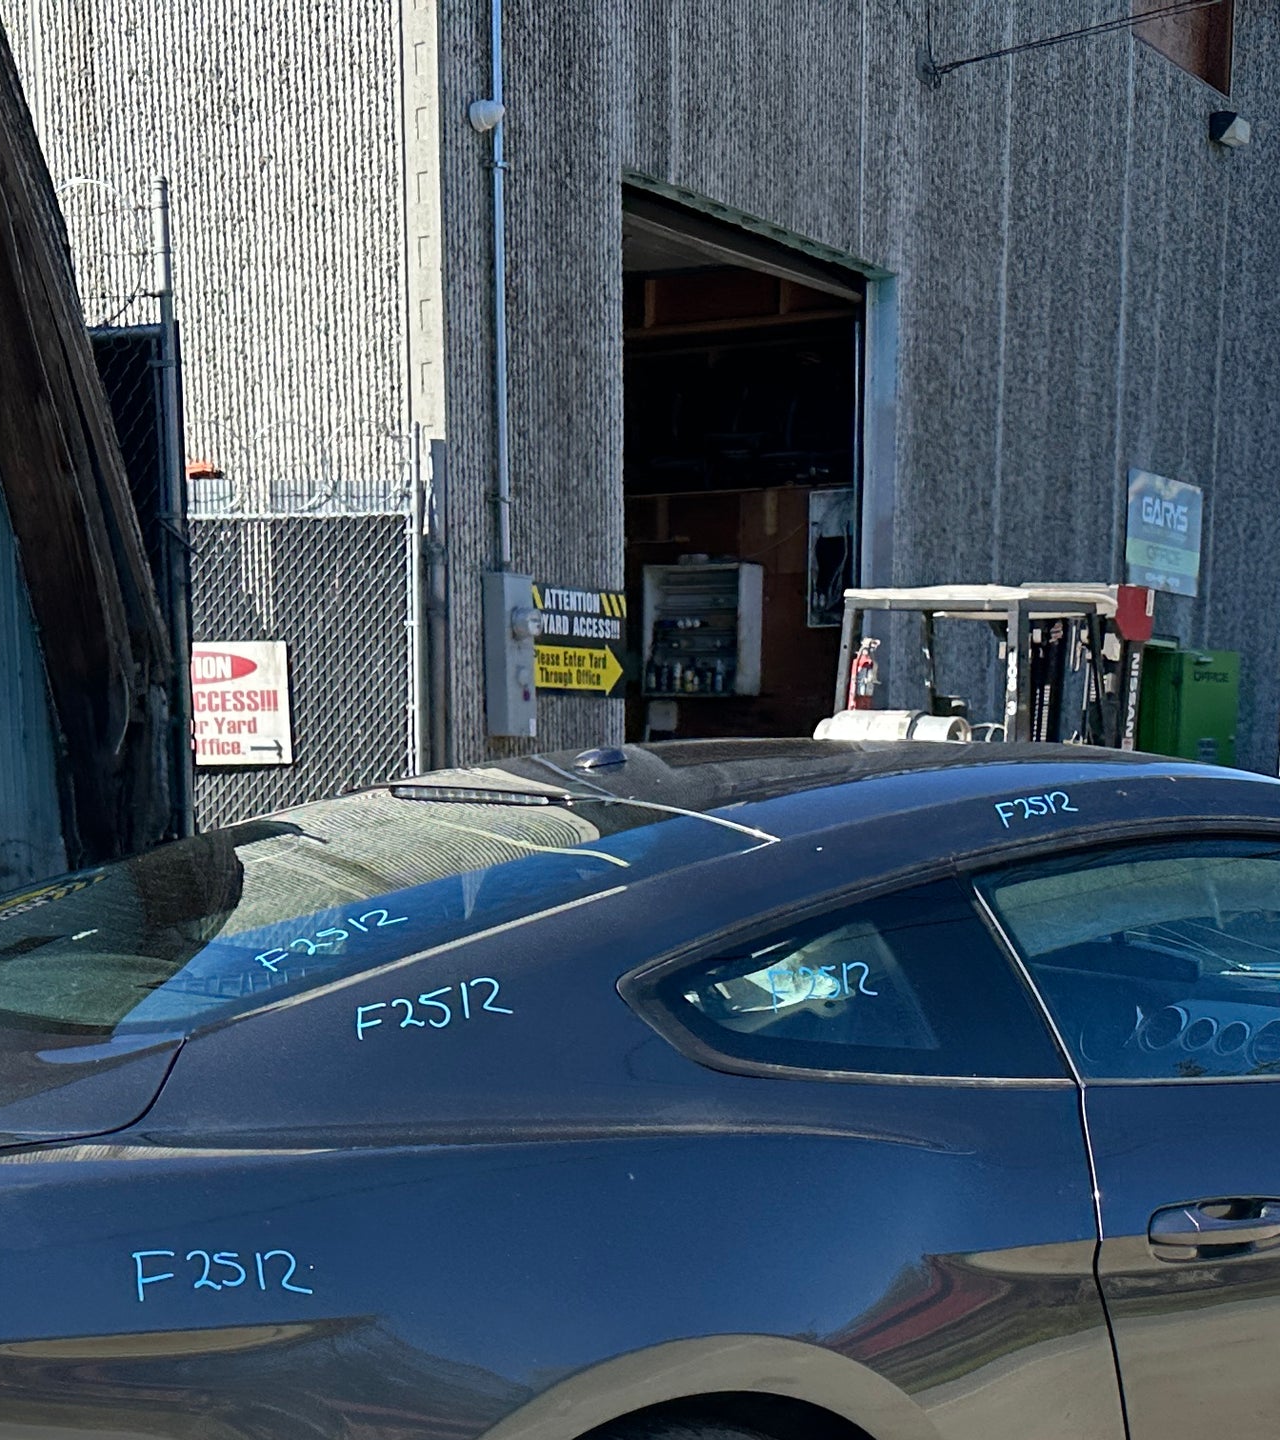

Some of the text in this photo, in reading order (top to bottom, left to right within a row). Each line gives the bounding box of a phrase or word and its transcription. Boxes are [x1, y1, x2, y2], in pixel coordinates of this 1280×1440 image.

[544, 588, 600, 613] ATTENTION
[542, 613, 620, 639] YARD ACCESS!!!
[194, 656, 232, 679] ION
[563, 651, 586, 667] Enter
[589, 653, 607, 669] Yard
[540, 667, 601, 686] Through Office
[194, 690, 278, 712] CCESS!!!
[1125, 652, 1140, 738] NISSAN
[214, 717, 258, 735] Yard
[995, 791, 1078, 827] F2512
[255, 908, 408, 973] F2512
[769, 961, 878, 1014] F2512
[355, 977, 513, 1041] F2512
[132, 1250, 313, 1302] F2512
